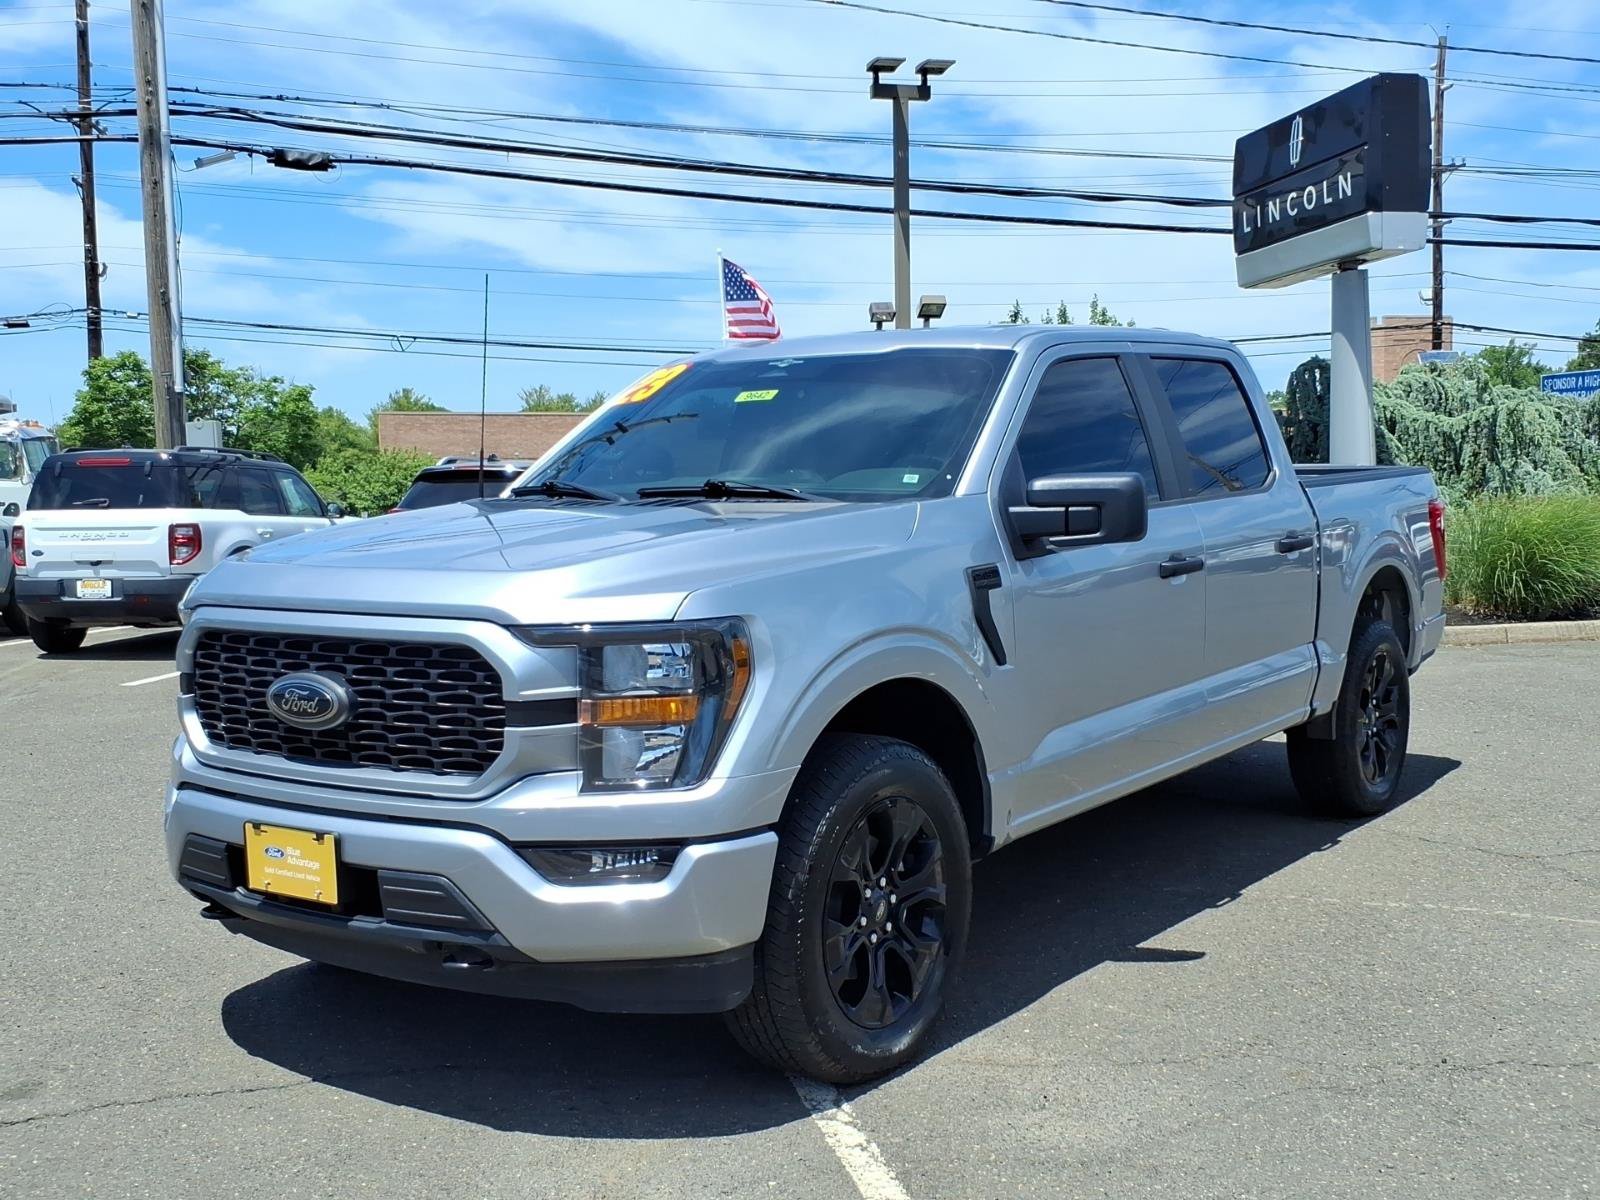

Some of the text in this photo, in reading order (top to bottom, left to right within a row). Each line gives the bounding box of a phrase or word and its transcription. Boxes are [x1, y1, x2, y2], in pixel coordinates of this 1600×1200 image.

[1243, 171, 1352, 233] LINCOLN
[1544, 377, 1576, 390] SPONSOR
[1578, 375, 1583, 388] A
[281, 688, 320, 713] Ford
[286, 856, 320, 870] Advantage
